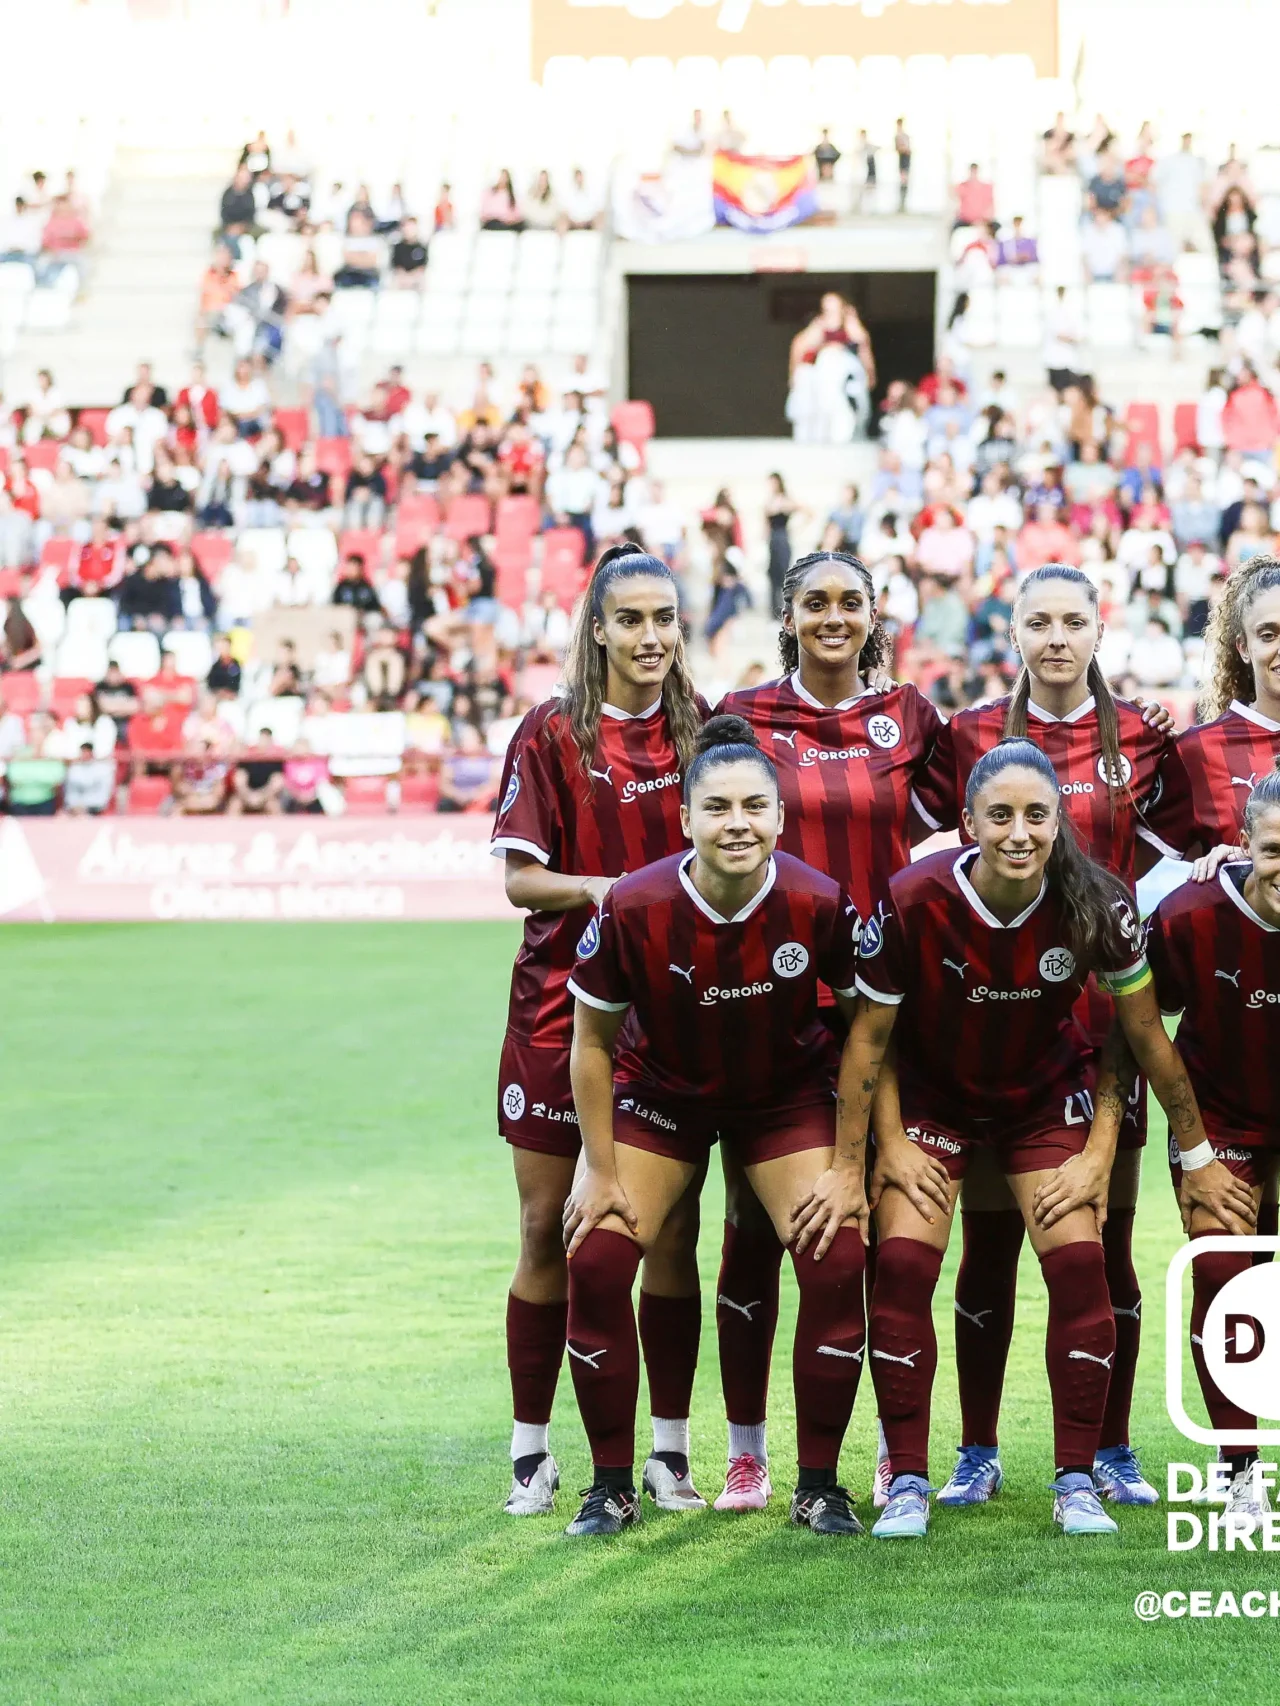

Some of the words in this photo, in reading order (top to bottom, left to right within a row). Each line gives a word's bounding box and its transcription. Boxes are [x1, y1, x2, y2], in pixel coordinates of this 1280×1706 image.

[803, 747, 870, 762] LOGROÑO
[622, 772, 681, 798] LOGROÑO
[704, 982, 774, 1002] LOGROÑO
[972, 986, 1042, 1001] LOGROÑO
[547, 1108, 561, 1122] La
[562, 1112, 579, 1124] Rio
[634, 1104, 648, 1119] La
[649, 1110, 678, 1132] Rioja
[922, 1132, 935, 1146] La
[936, 1136, 961, 1155] Rioja
[1213, 1147, 1225, 1160] La
[1226, 1149, 1253, 1161] Rioja
